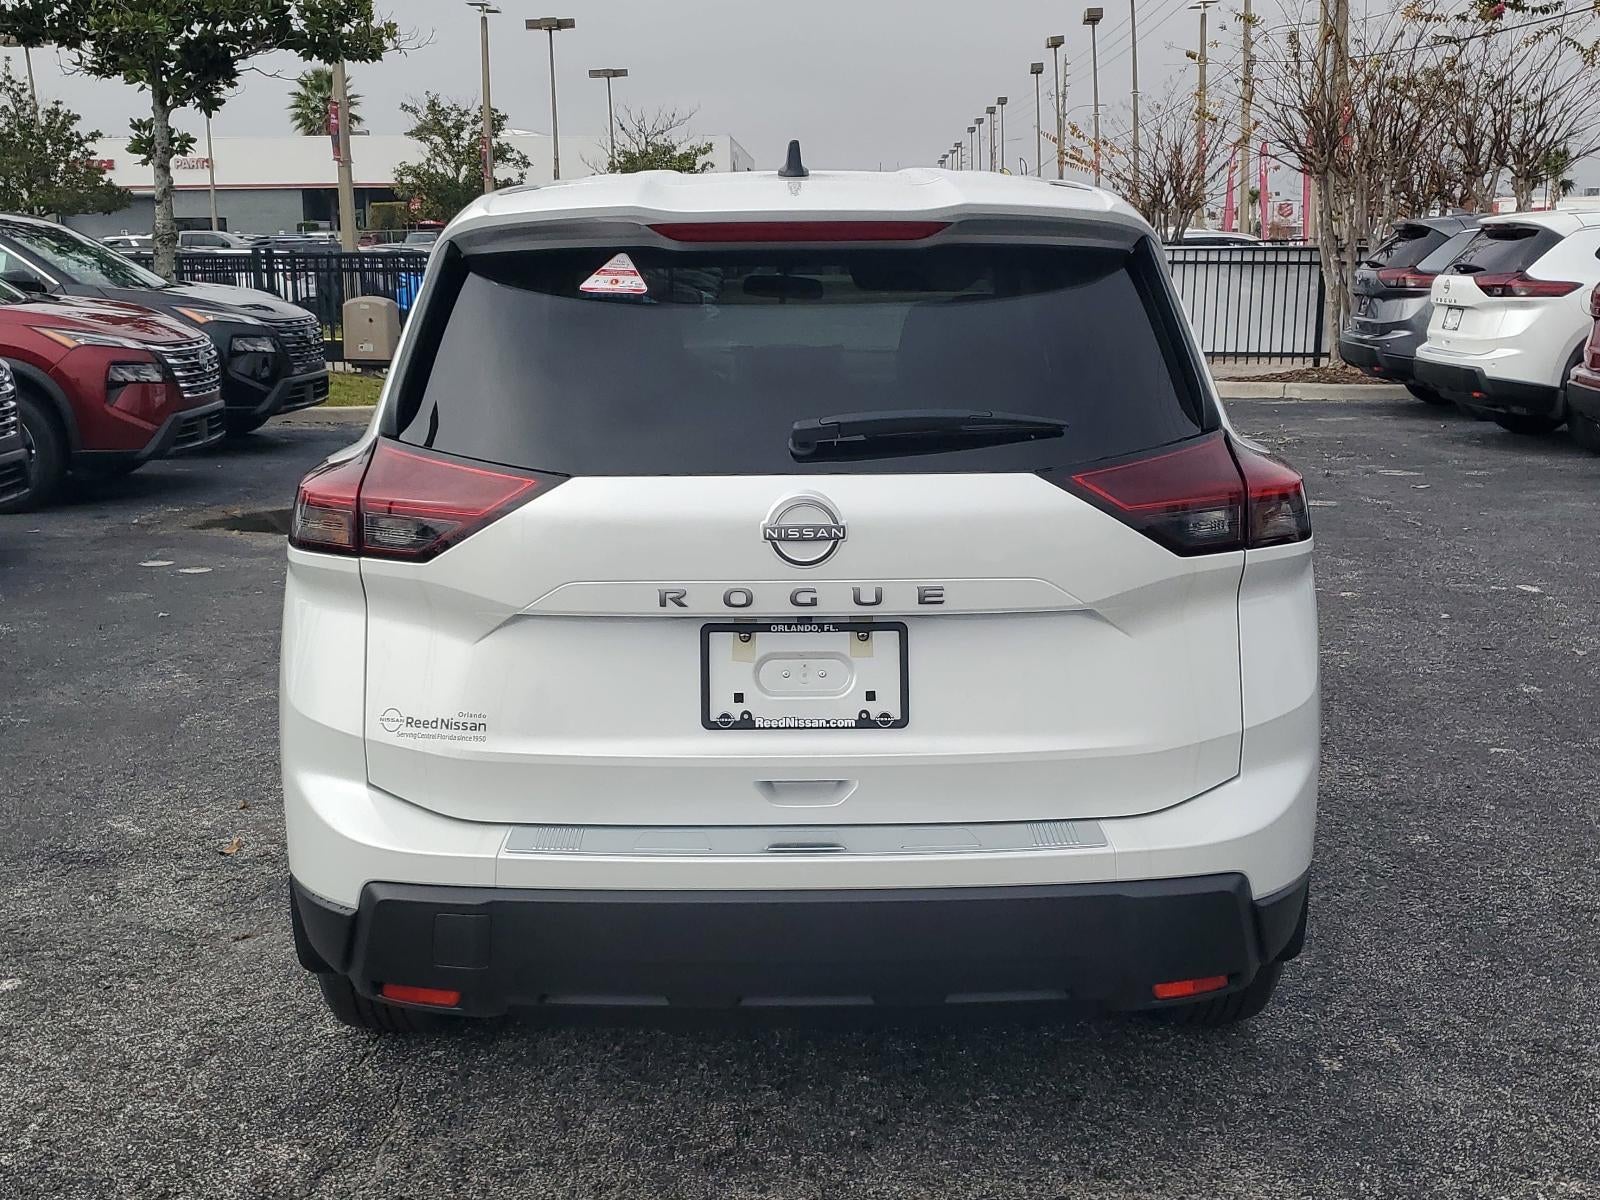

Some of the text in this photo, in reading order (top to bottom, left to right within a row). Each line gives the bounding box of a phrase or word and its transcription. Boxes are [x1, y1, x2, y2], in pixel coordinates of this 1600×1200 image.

[175, 158, 212, 169] PARTS
[766, 527, 845, 539] NISSAN
[657, 585, 946, 608] ROGUE
[770, 624, 839, 633] ORLANDO, FL.
[458, 711, 487, 719] Orlando
[755, 716, 856, 729] ReedNissan.com
[396, 731, 417, 739] Serving
